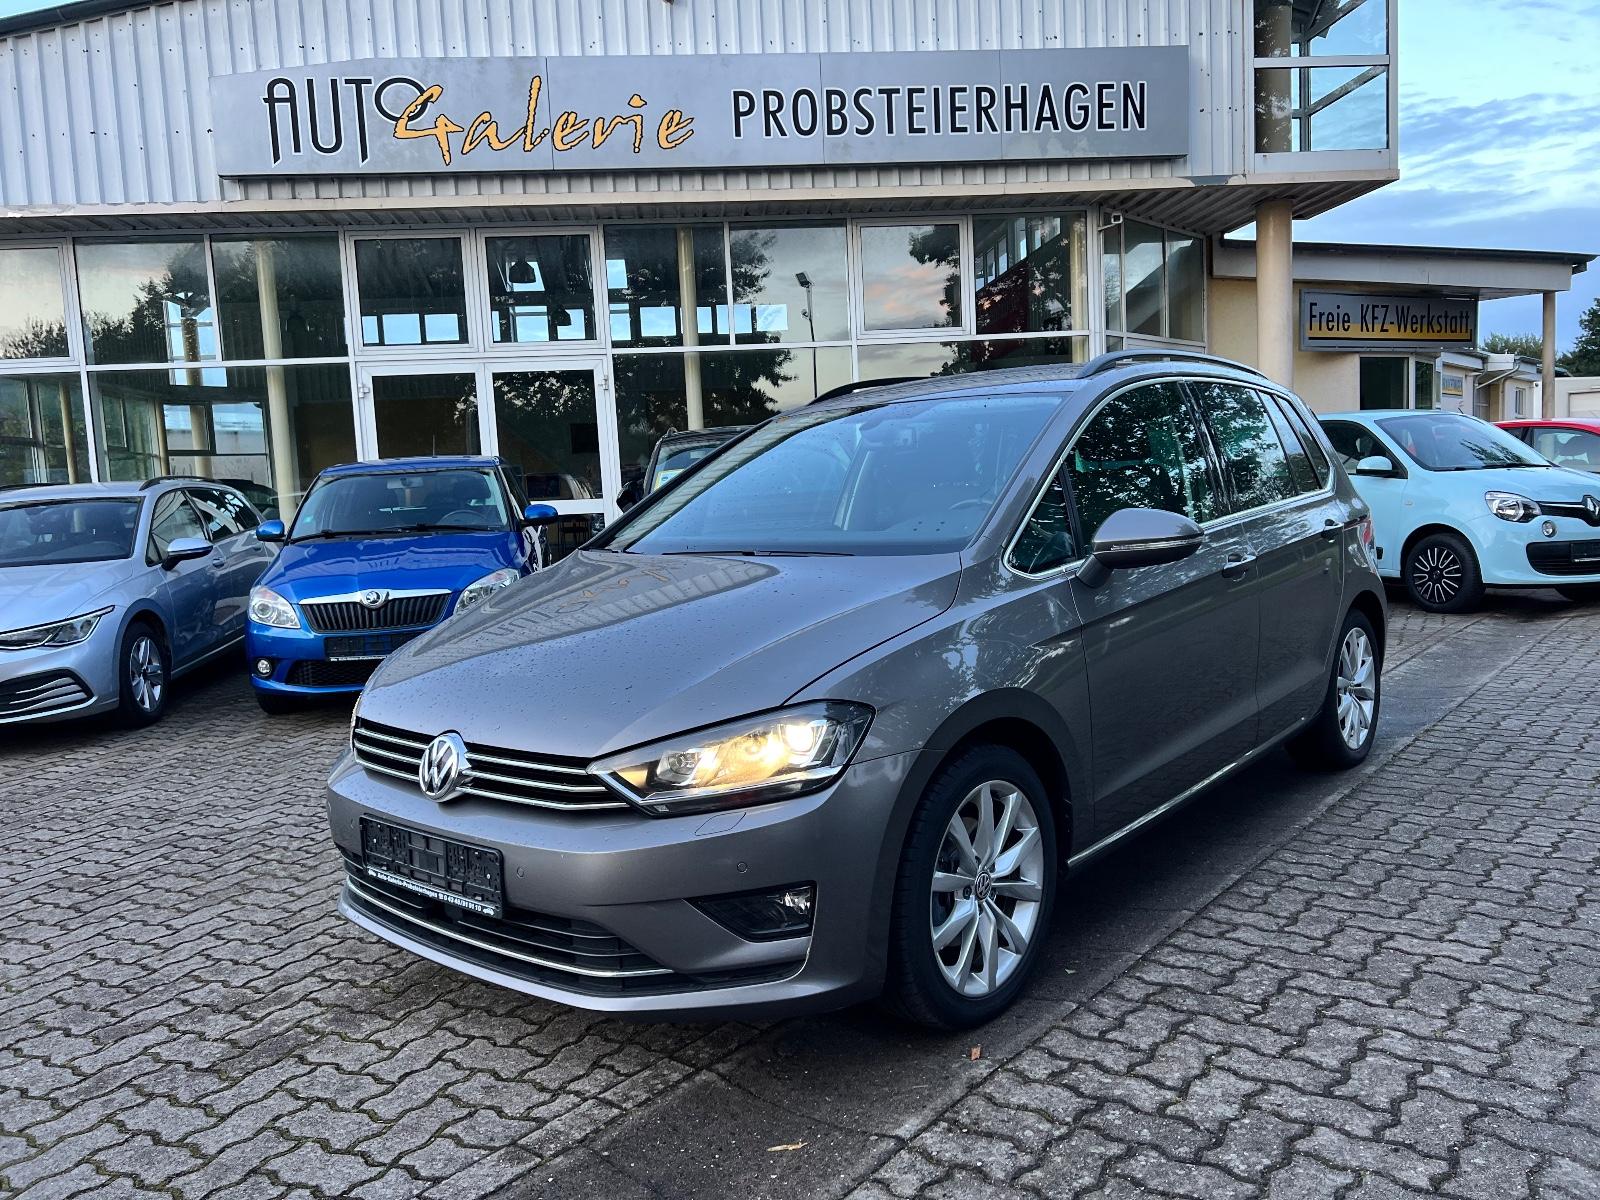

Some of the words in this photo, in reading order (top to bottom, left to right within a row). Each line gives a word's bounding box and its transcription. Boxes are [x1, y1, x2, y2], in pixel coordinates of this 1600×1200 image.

[262, 76, 429, 167] AUTO
[394, 75, 695, 167] Galerie
[731, 81, 1148, 139] PROBSTEIERHAGEN
[1308, 302, 1351, 332] Freie
[1360, 304, 1470, 334] KFZ-Werkstatt
